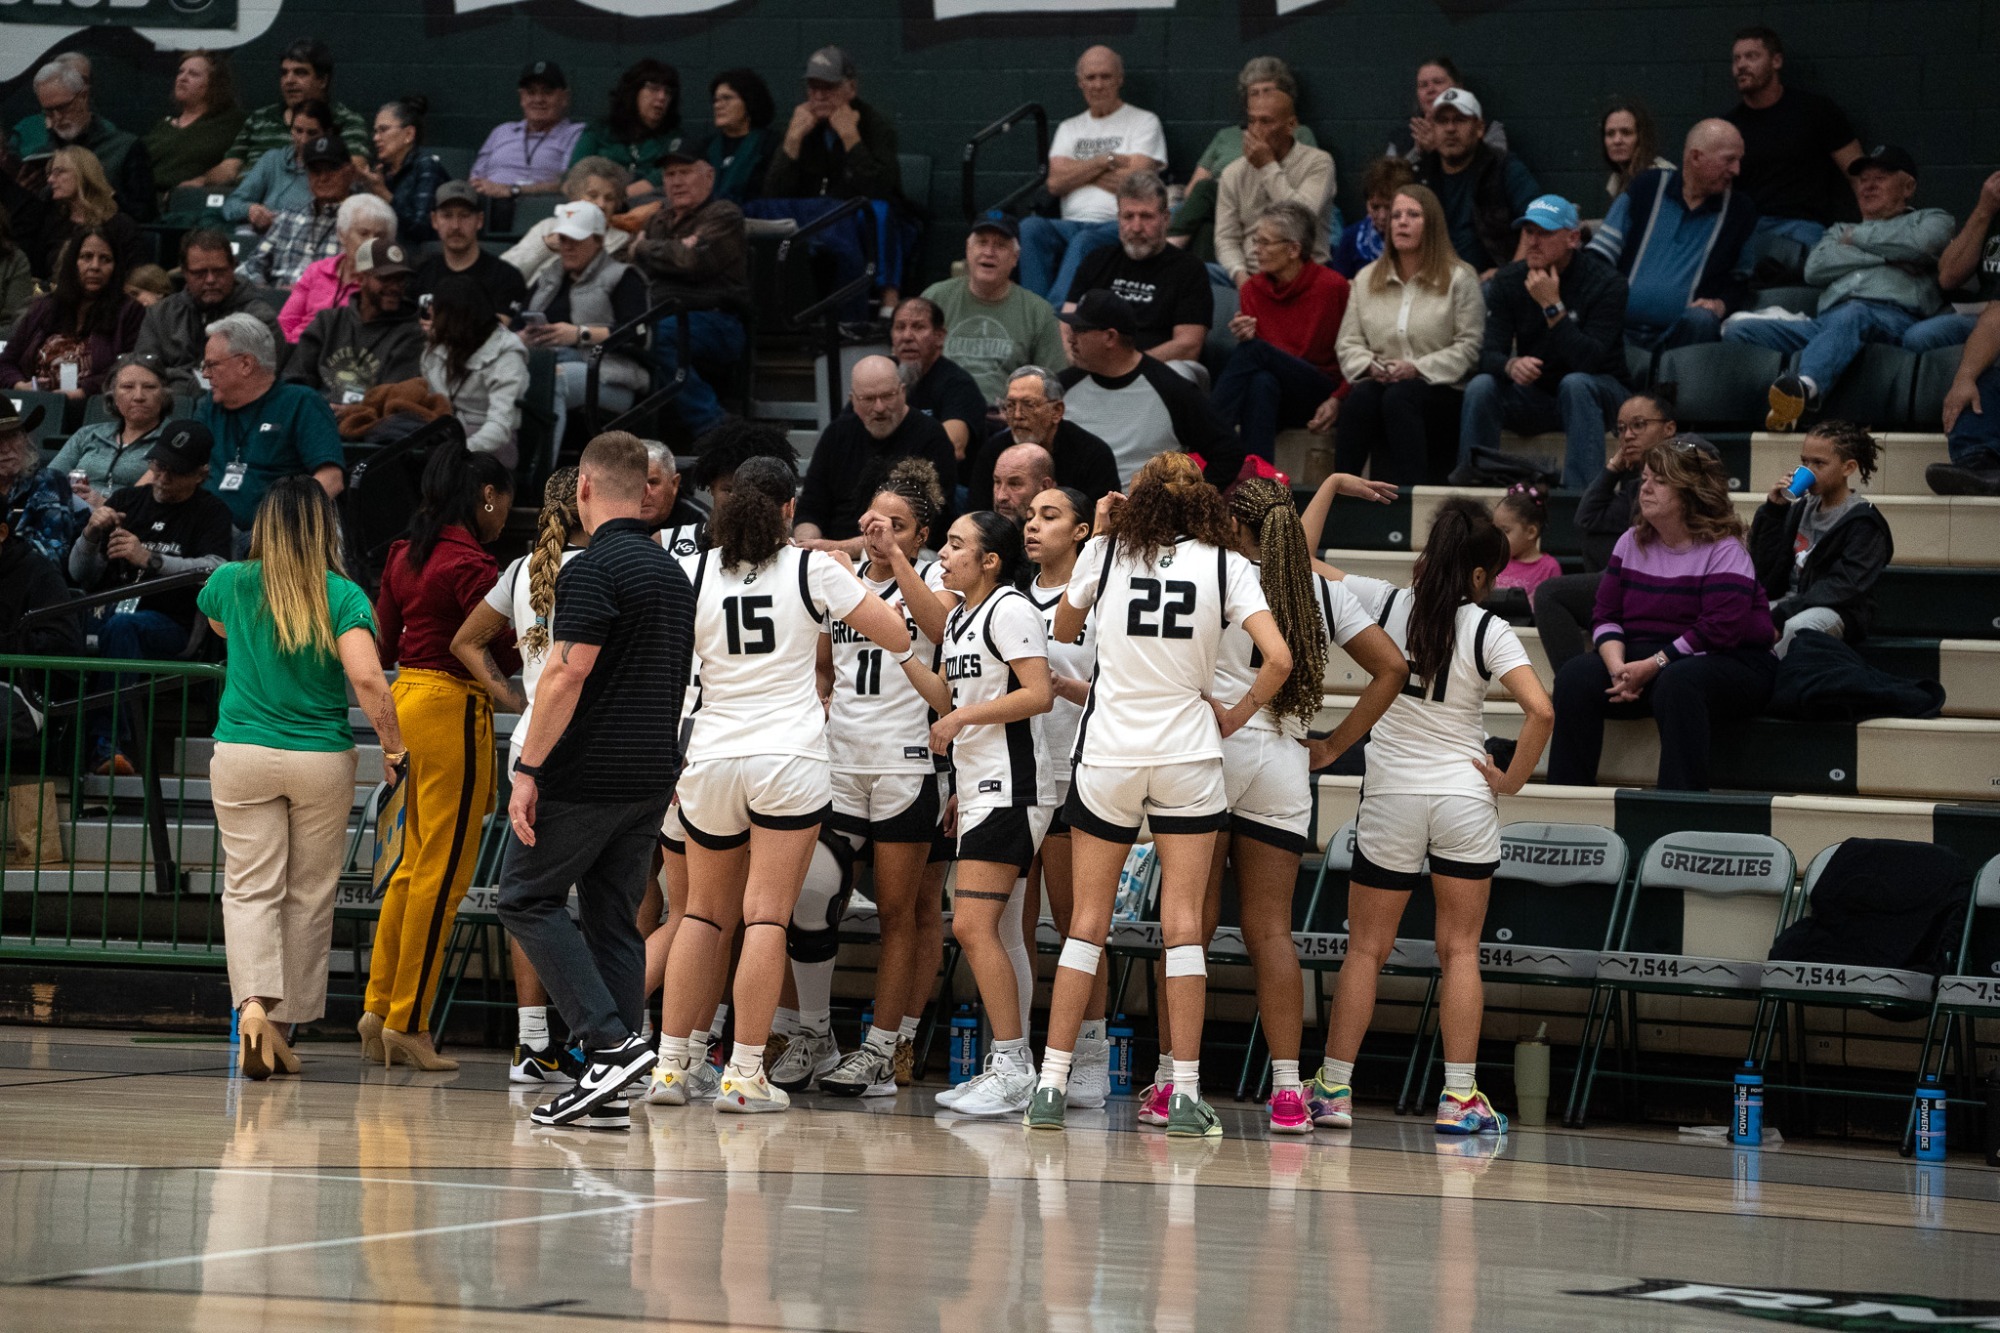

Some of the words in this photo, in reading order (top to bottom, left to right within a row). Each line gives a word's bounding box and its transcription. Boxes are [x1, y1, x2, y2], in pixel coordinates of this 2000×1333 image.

[1126, 576, 1197, 640] 22
[722, 594, 776, 655] 15
[832, 618, 918, 644] GRIZS
[856, 648, 882, 696] 11
[1500, 843, 1606, 867] GRIZZLIES
[1660, 850, 1772, 877] GRIZZLIES
[1304, 937, 1348, 957] 7,544
[1479, 949, 1513, 968] 544
[1628, 957, 1679, 979] 7,544
[1795, 965, 1847, 988] 7,544
